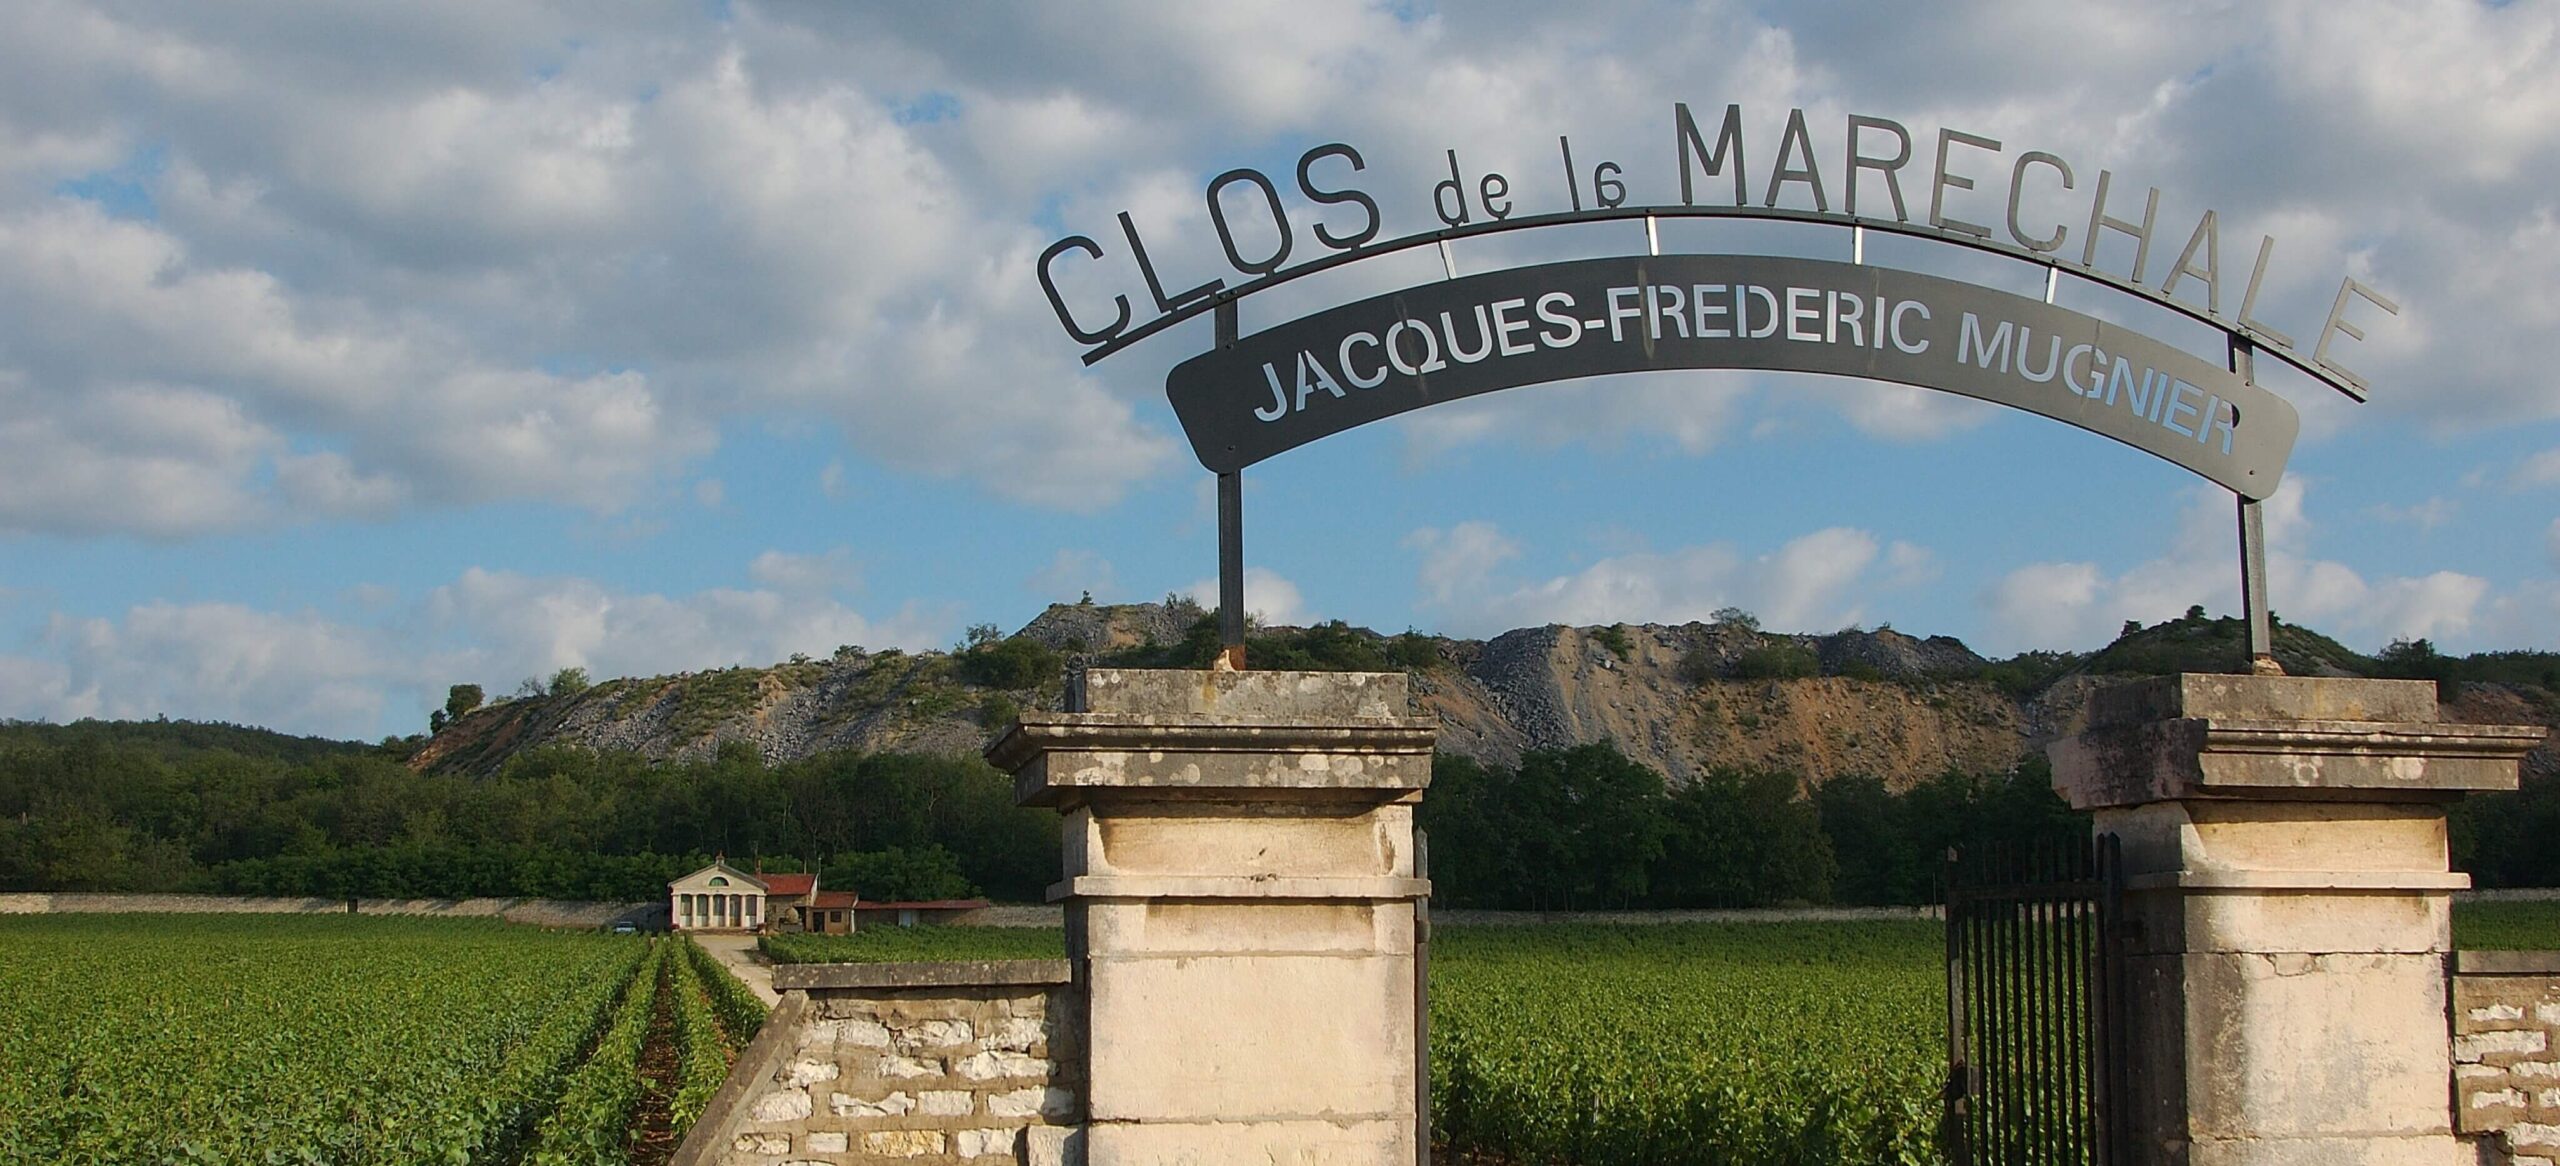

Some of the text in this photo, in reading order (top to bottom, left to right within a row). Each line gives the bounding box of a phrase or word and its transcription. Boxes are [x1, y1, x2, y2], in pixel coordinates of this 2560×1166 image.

[1036, 102, 2400, 392] CLOS de la MARECHALE
[1252, 283, 2241, 456] JACQUES-FREDERIC MUGNIER
